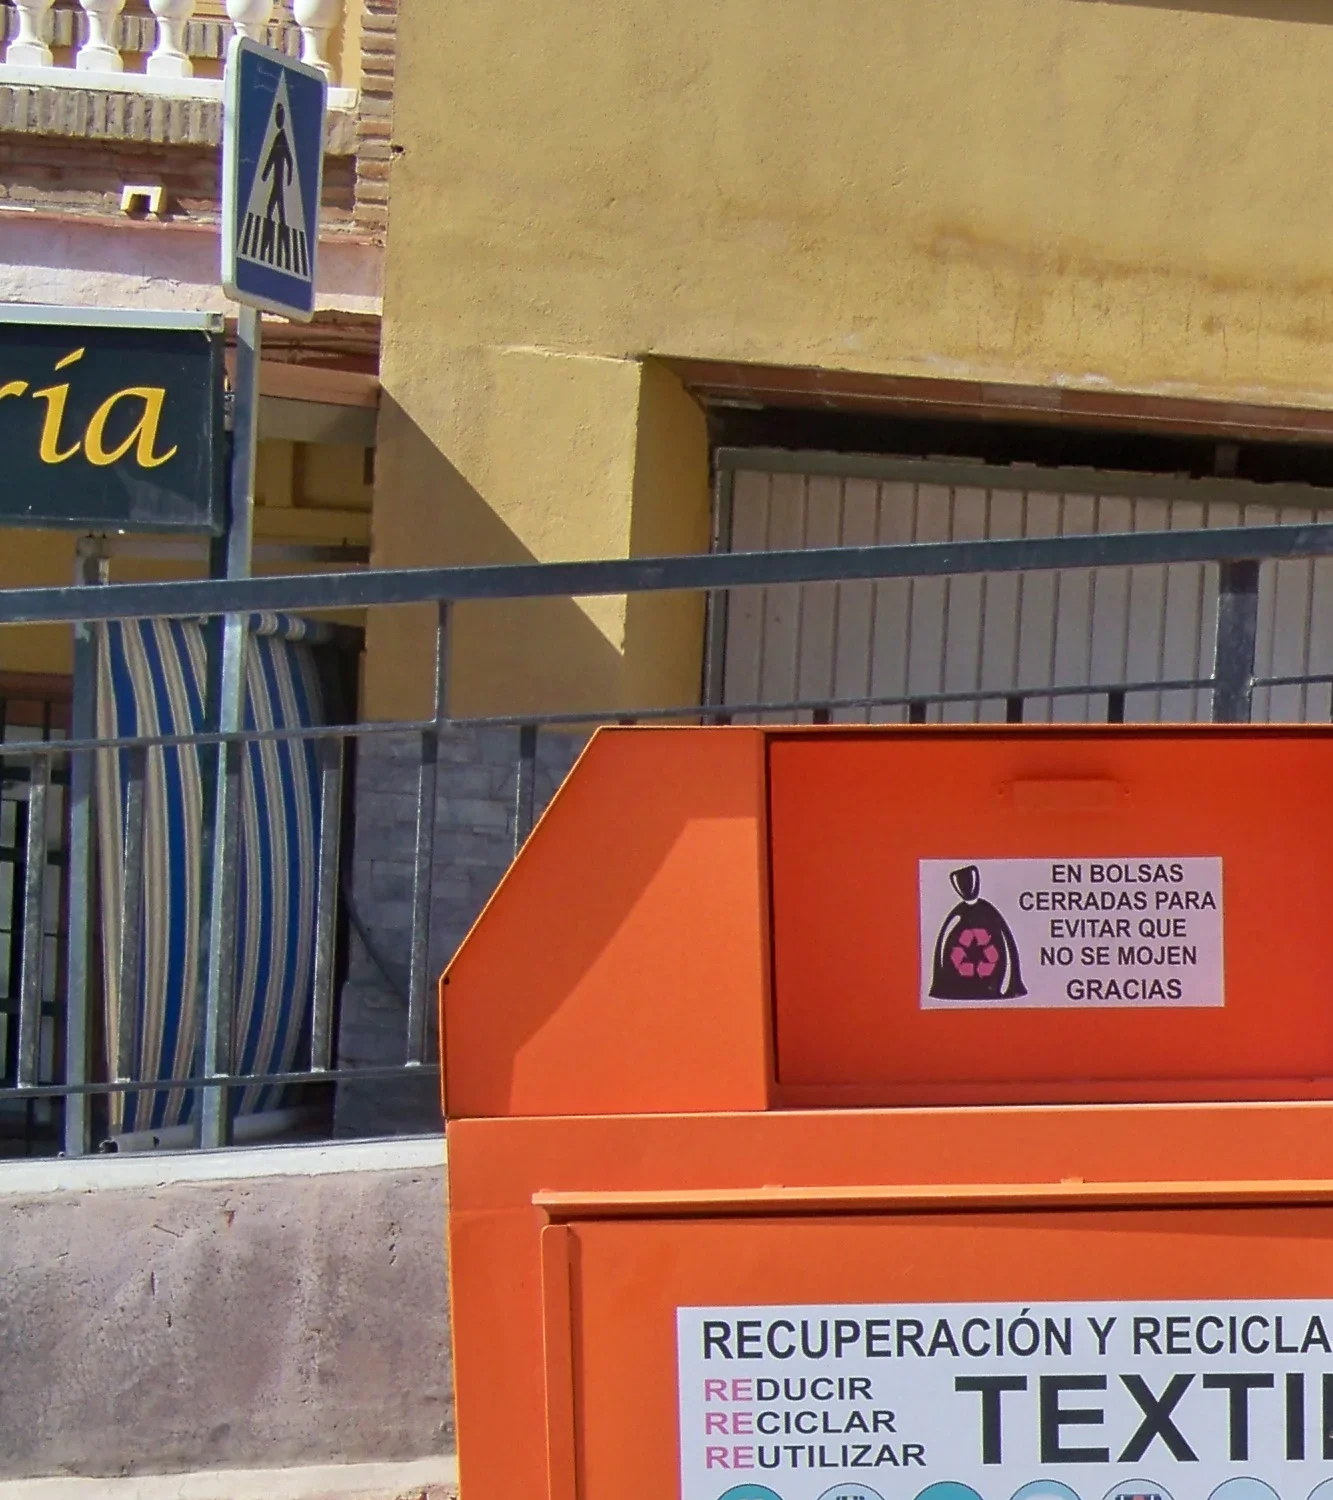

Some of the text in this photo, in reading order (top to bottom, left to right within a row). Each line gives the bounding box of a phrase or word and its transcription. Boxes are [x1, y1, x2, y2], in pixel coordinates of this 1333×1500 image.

[0, 347, 178, 467] ía
[1052, 864, 1184, 884] EN BOLSAS
[1019, 891, 1216, 911] CERRADAS PARA
[1050, 919, 1187, 939] EVITAR QUE
[1040, 946, 1197, 966] NO SE MOJEN
[1066, 979, 1183, 1000] GRACIAS
[703, 1308, 1072, 1359] RECUPERACIÓN
[1087, 1317, 1117, 1355] Y
[704, 1377, 874, 1402] REDUCIR
[705, 1410, 897, 1435] RECICLAR
[705, 1444, 927, 1469] REUTILIZAR
